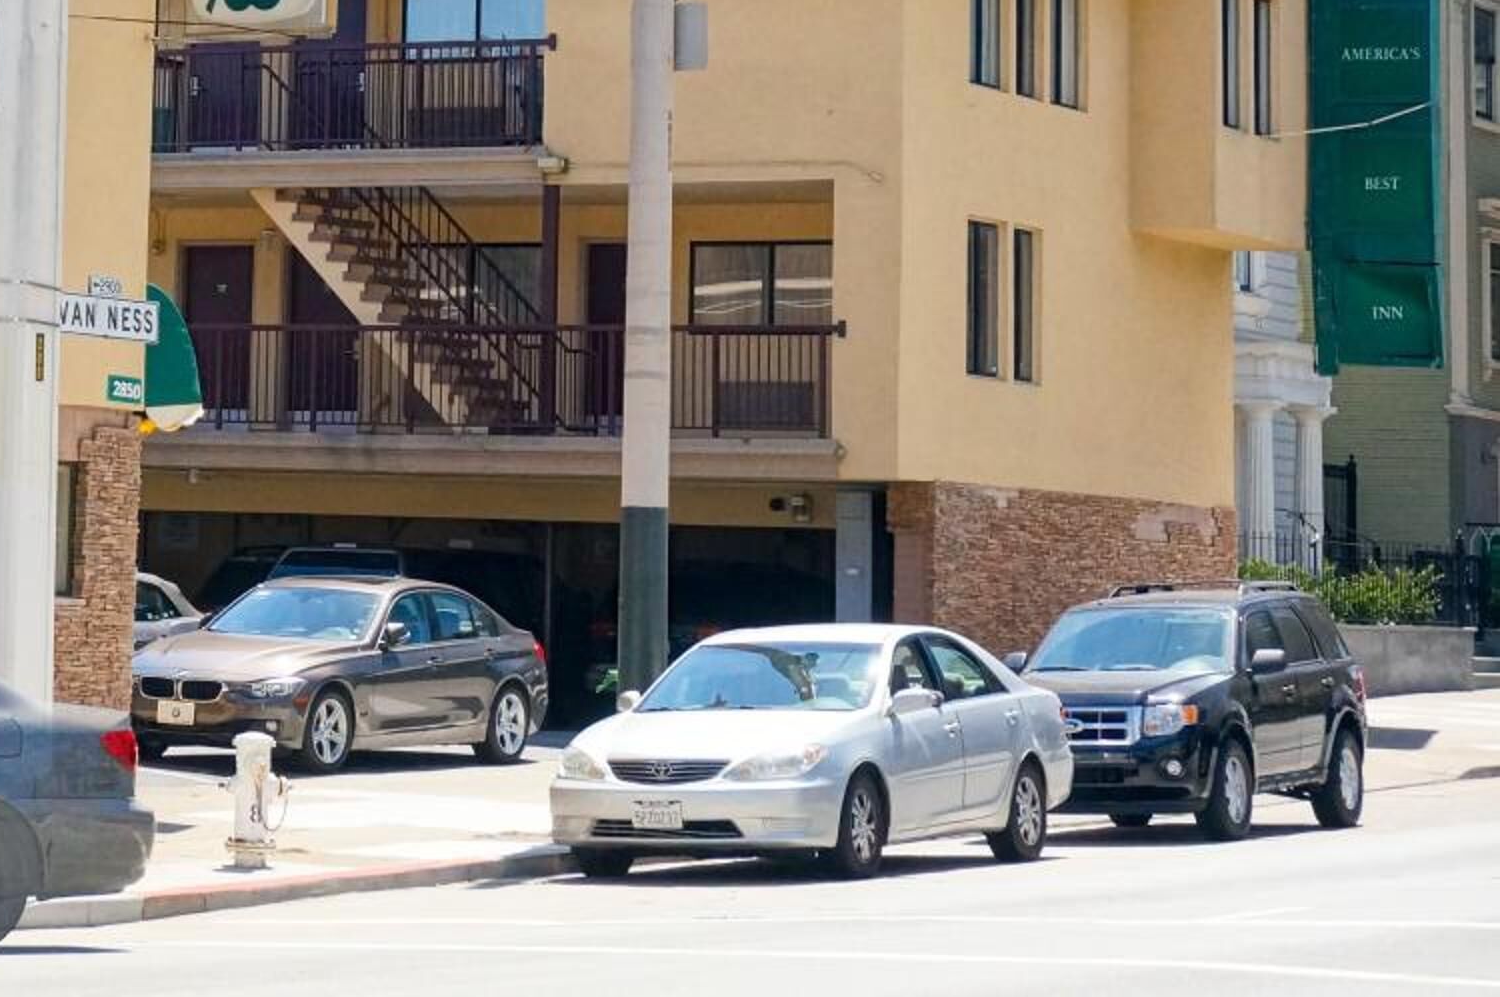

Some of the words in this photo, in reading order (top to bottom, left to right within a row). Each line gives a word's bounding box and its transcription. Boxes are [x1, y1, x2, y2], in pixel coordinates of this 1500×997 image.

[1341, 47, 1421, 61] AMERICA'S
[1365, 176, 1399, 191] BEST
[59, 301, 95, 328] VAN
[106, 306, 153, 334] NESS
[1373, 305, 1403, 319] INN
